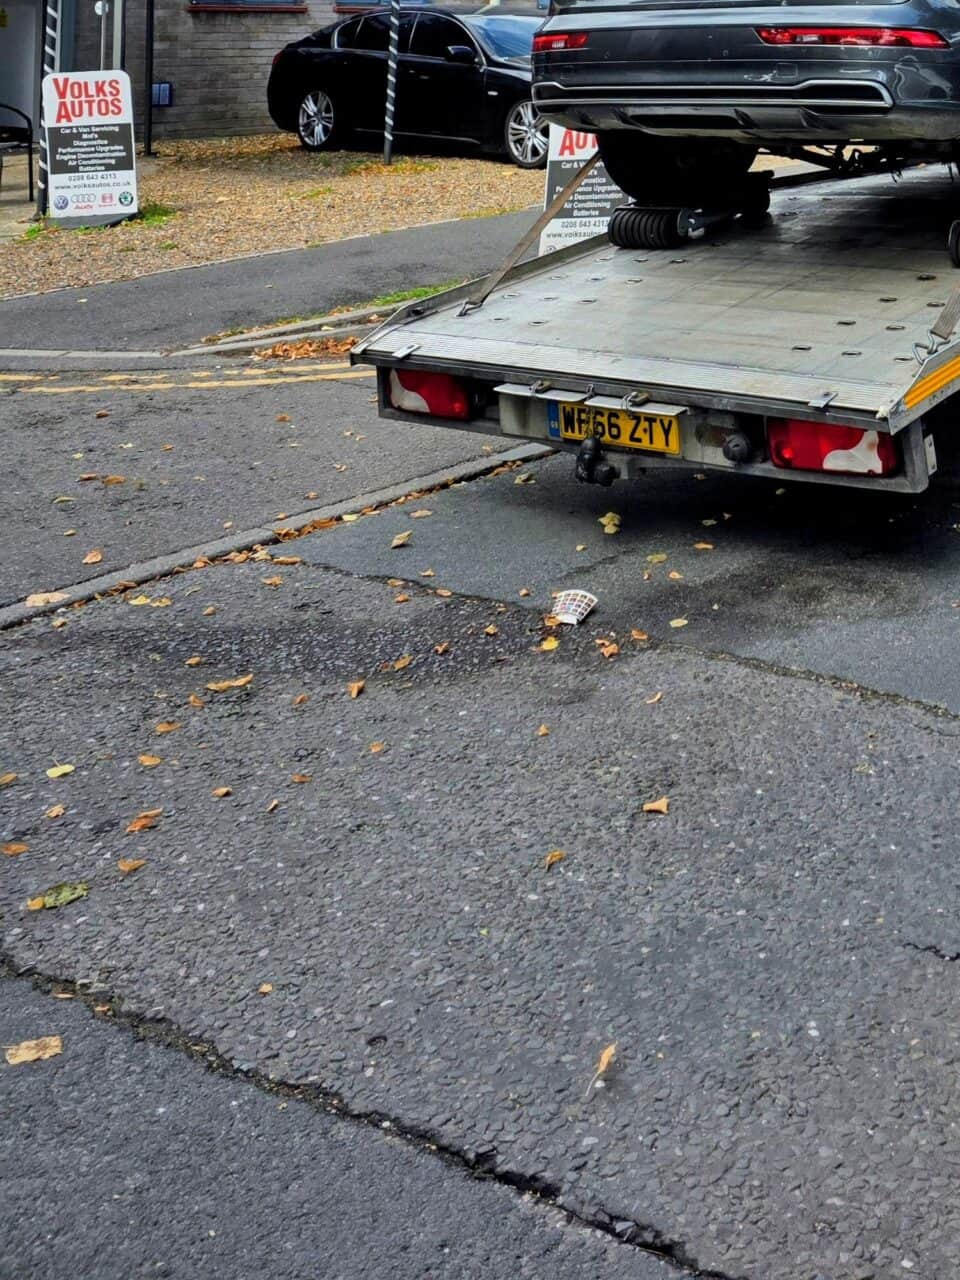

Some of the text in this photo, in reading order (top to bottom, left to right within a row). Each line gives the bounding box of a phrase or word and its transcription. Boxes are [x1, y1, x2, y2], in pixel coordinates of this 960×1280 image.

[52, 77, 120, 99] VOLKS
[56, 98, 122, 123] AUTOS
[629, 415, 674, 447] ZTY
